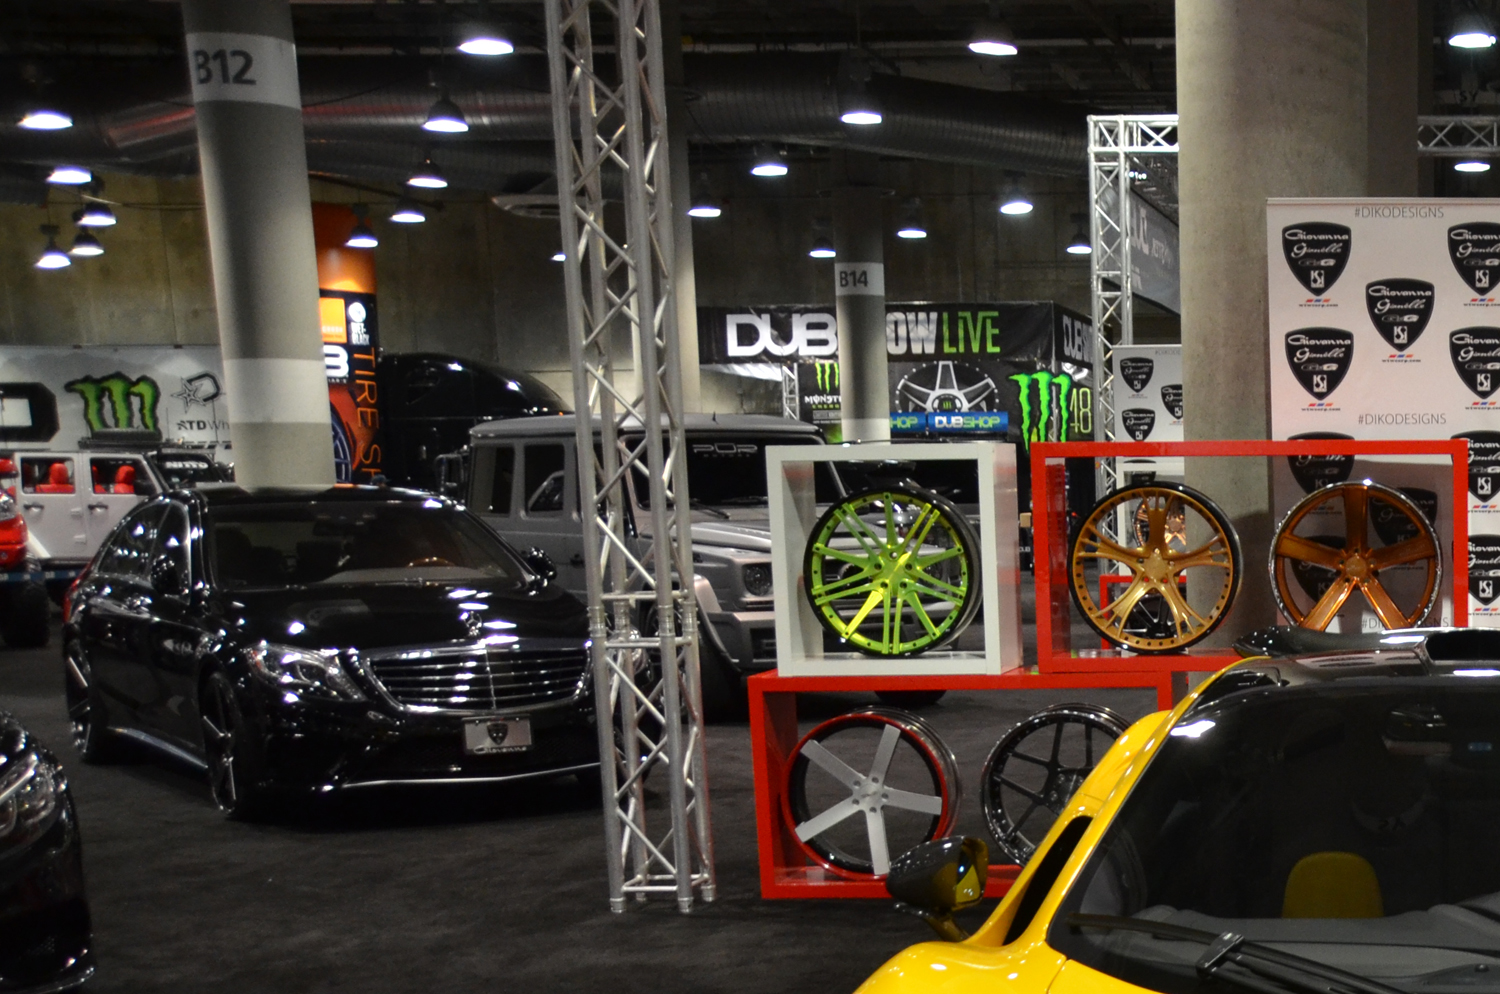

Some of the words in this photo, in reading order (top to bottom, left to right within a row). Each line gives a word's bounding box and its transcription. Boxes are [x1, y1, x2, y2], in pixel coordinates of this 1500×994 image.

[193, 49, 257, 85] B12
[1354, 206, 1445, 220] #DIKODESIGNS
[1284, 229, 1349, 240] Giovanna
[839, 270, 868, 287] B14
[1368, 285, 1432, 296] Giovanna
[726, 312, 838, 356] DUB
[886, 311, 938, 355] OW
[1287, 334, 1351, 345] Giovanna
[353, 347, 380, 429] TIRE
[1358, 413, 1447, 425] #DIKODESIGNS
